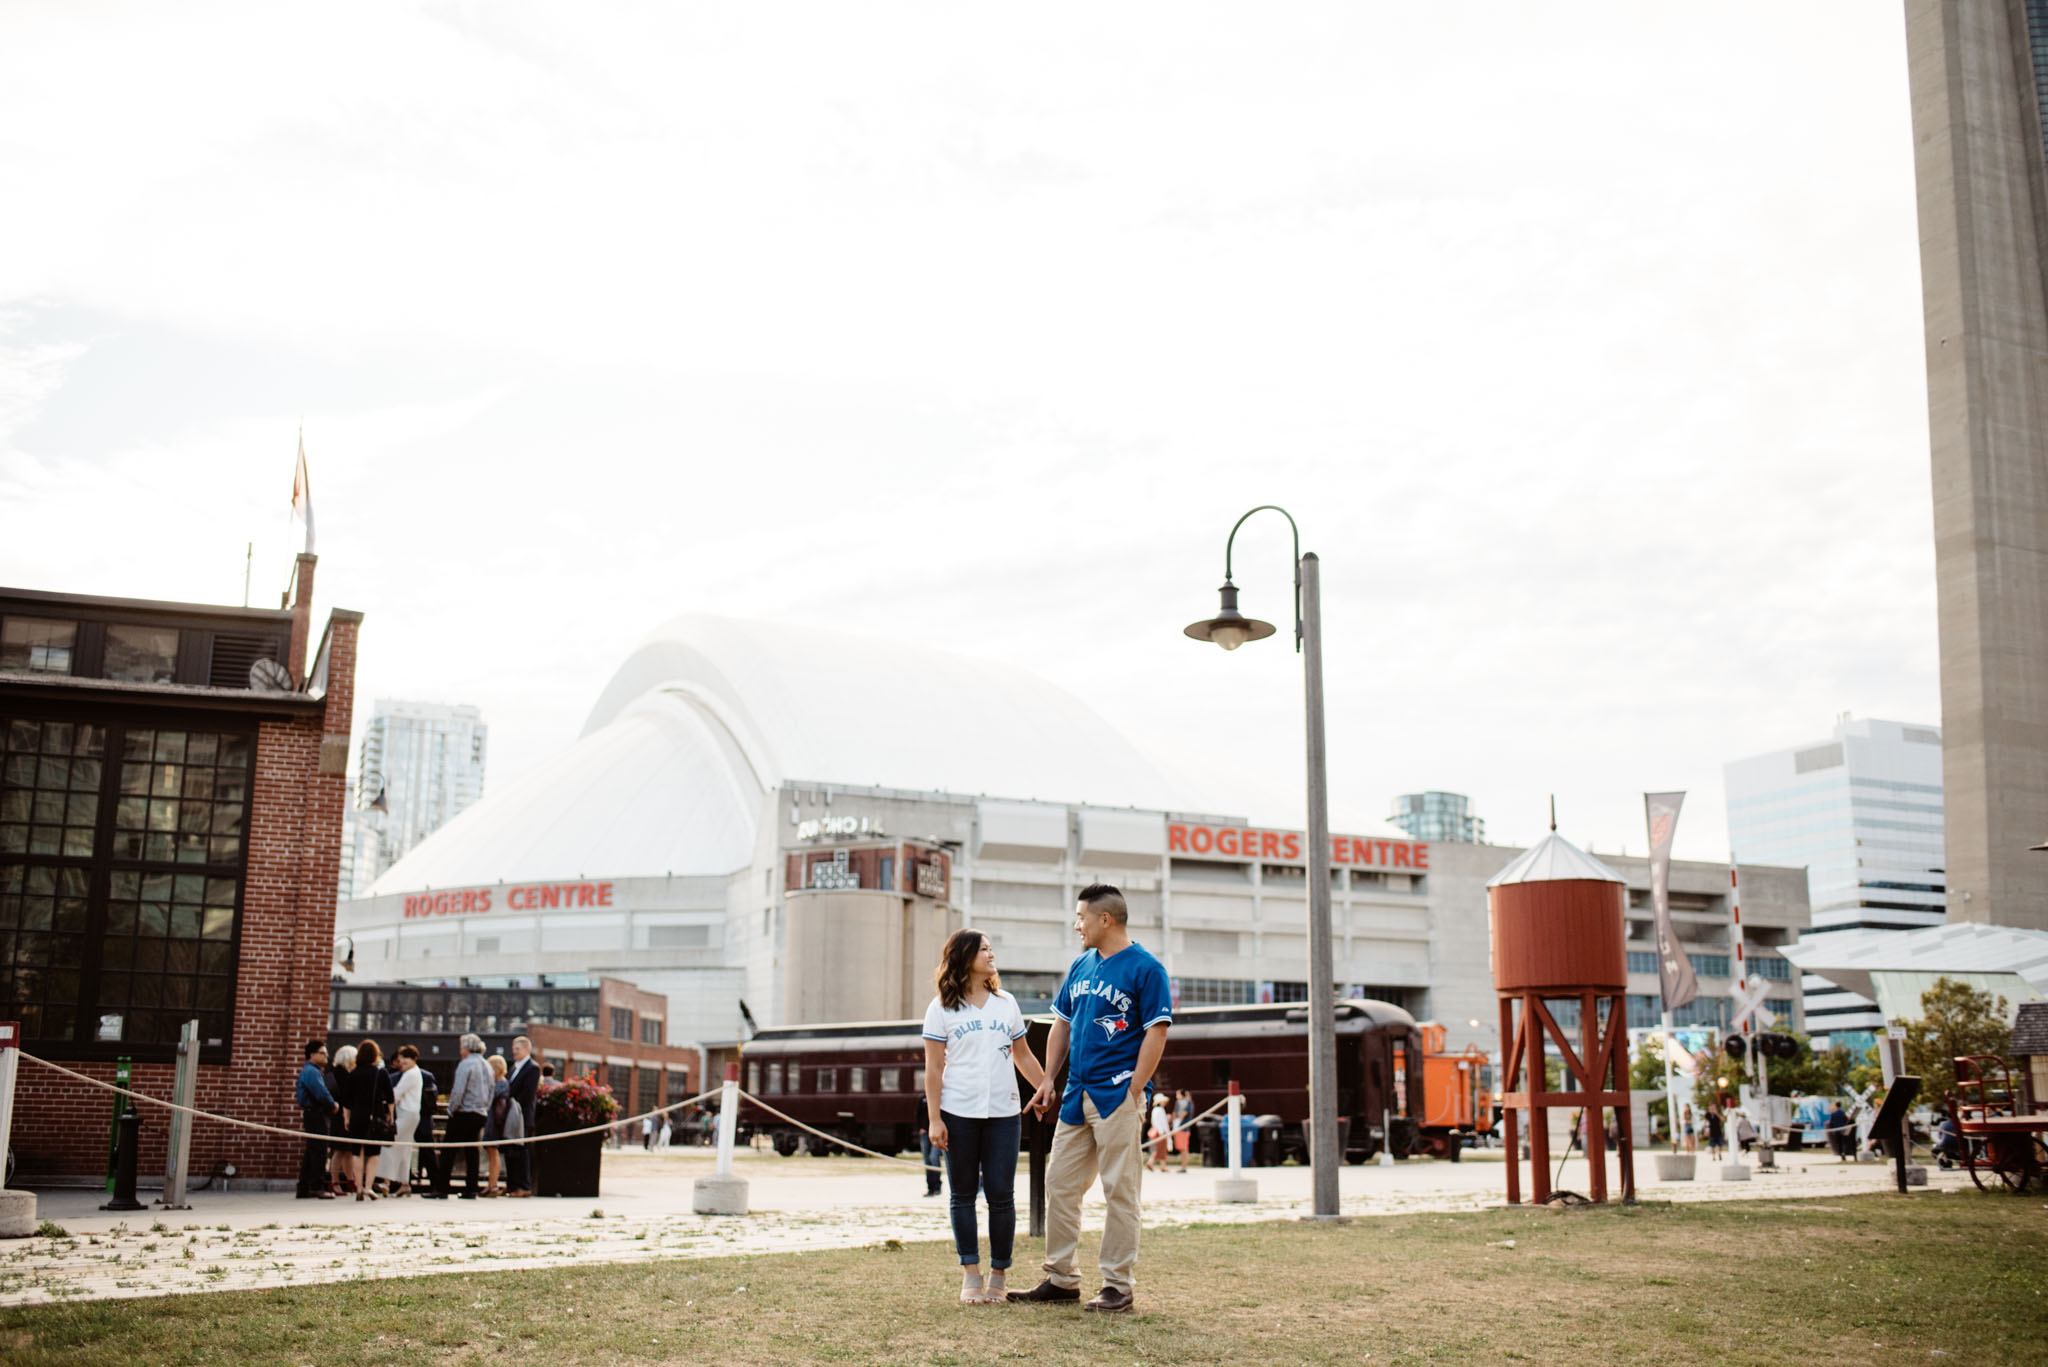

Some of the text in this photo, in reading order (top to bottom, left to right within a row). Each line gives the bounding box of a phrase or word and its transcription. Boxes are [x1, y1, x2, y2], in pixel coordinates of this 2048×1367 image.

[1168, 824, 1430, 869] ROGERS ENTRE
[403, 881, 614, 918] ROGERS CENTRE
[1091, 979, 1133, 1012] JAYS
[953, 1019, 983, 1040] BLUE
